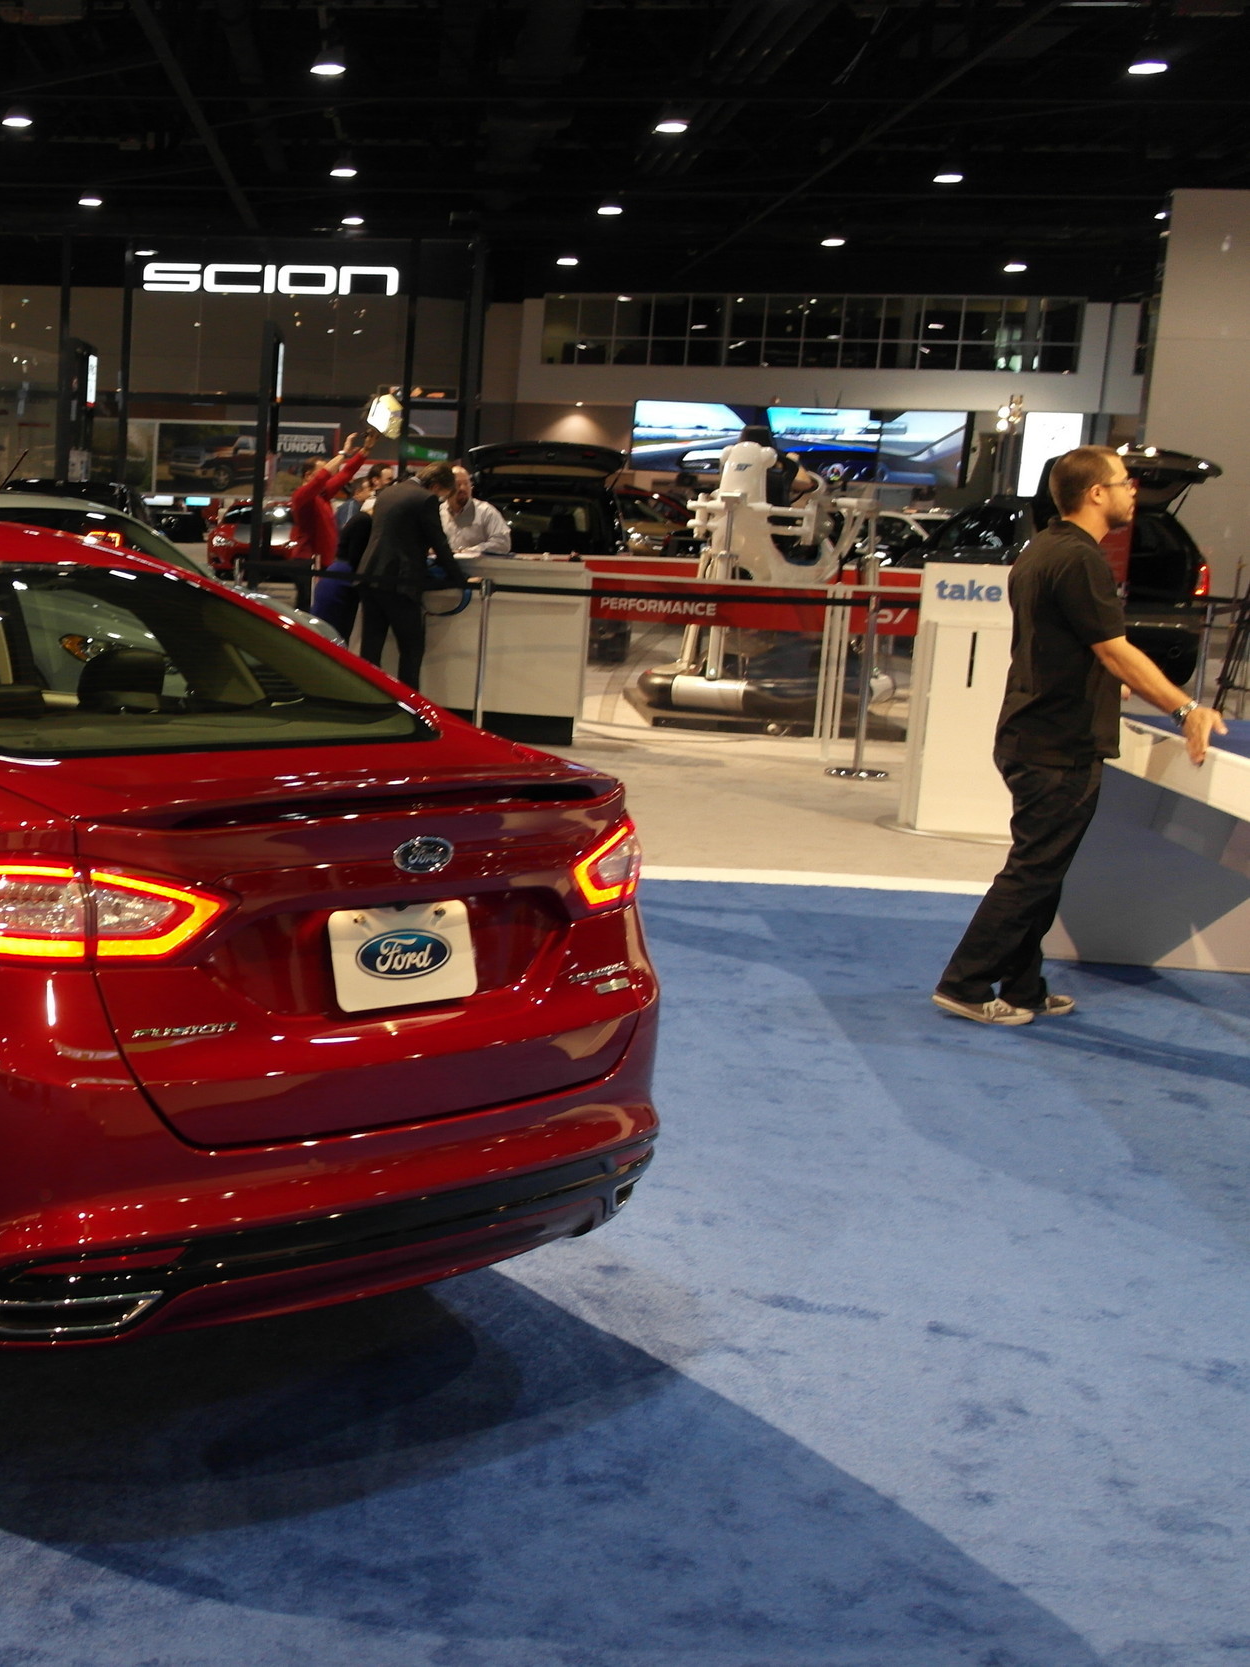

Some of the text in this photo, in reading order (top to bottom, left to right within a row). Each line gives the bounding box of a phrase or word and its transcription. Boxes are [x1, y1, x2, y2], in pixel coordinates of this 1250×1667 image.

[142, 262, 400, 296] SCION
[936, 579, 1003, 602] take
[600, 597, 717, 617] PERFORMANCE
[407, 842, 443, 866] Ford
[375, 936, 433, 972] Ford
[131, 1021, 238, 1039] FUSION
